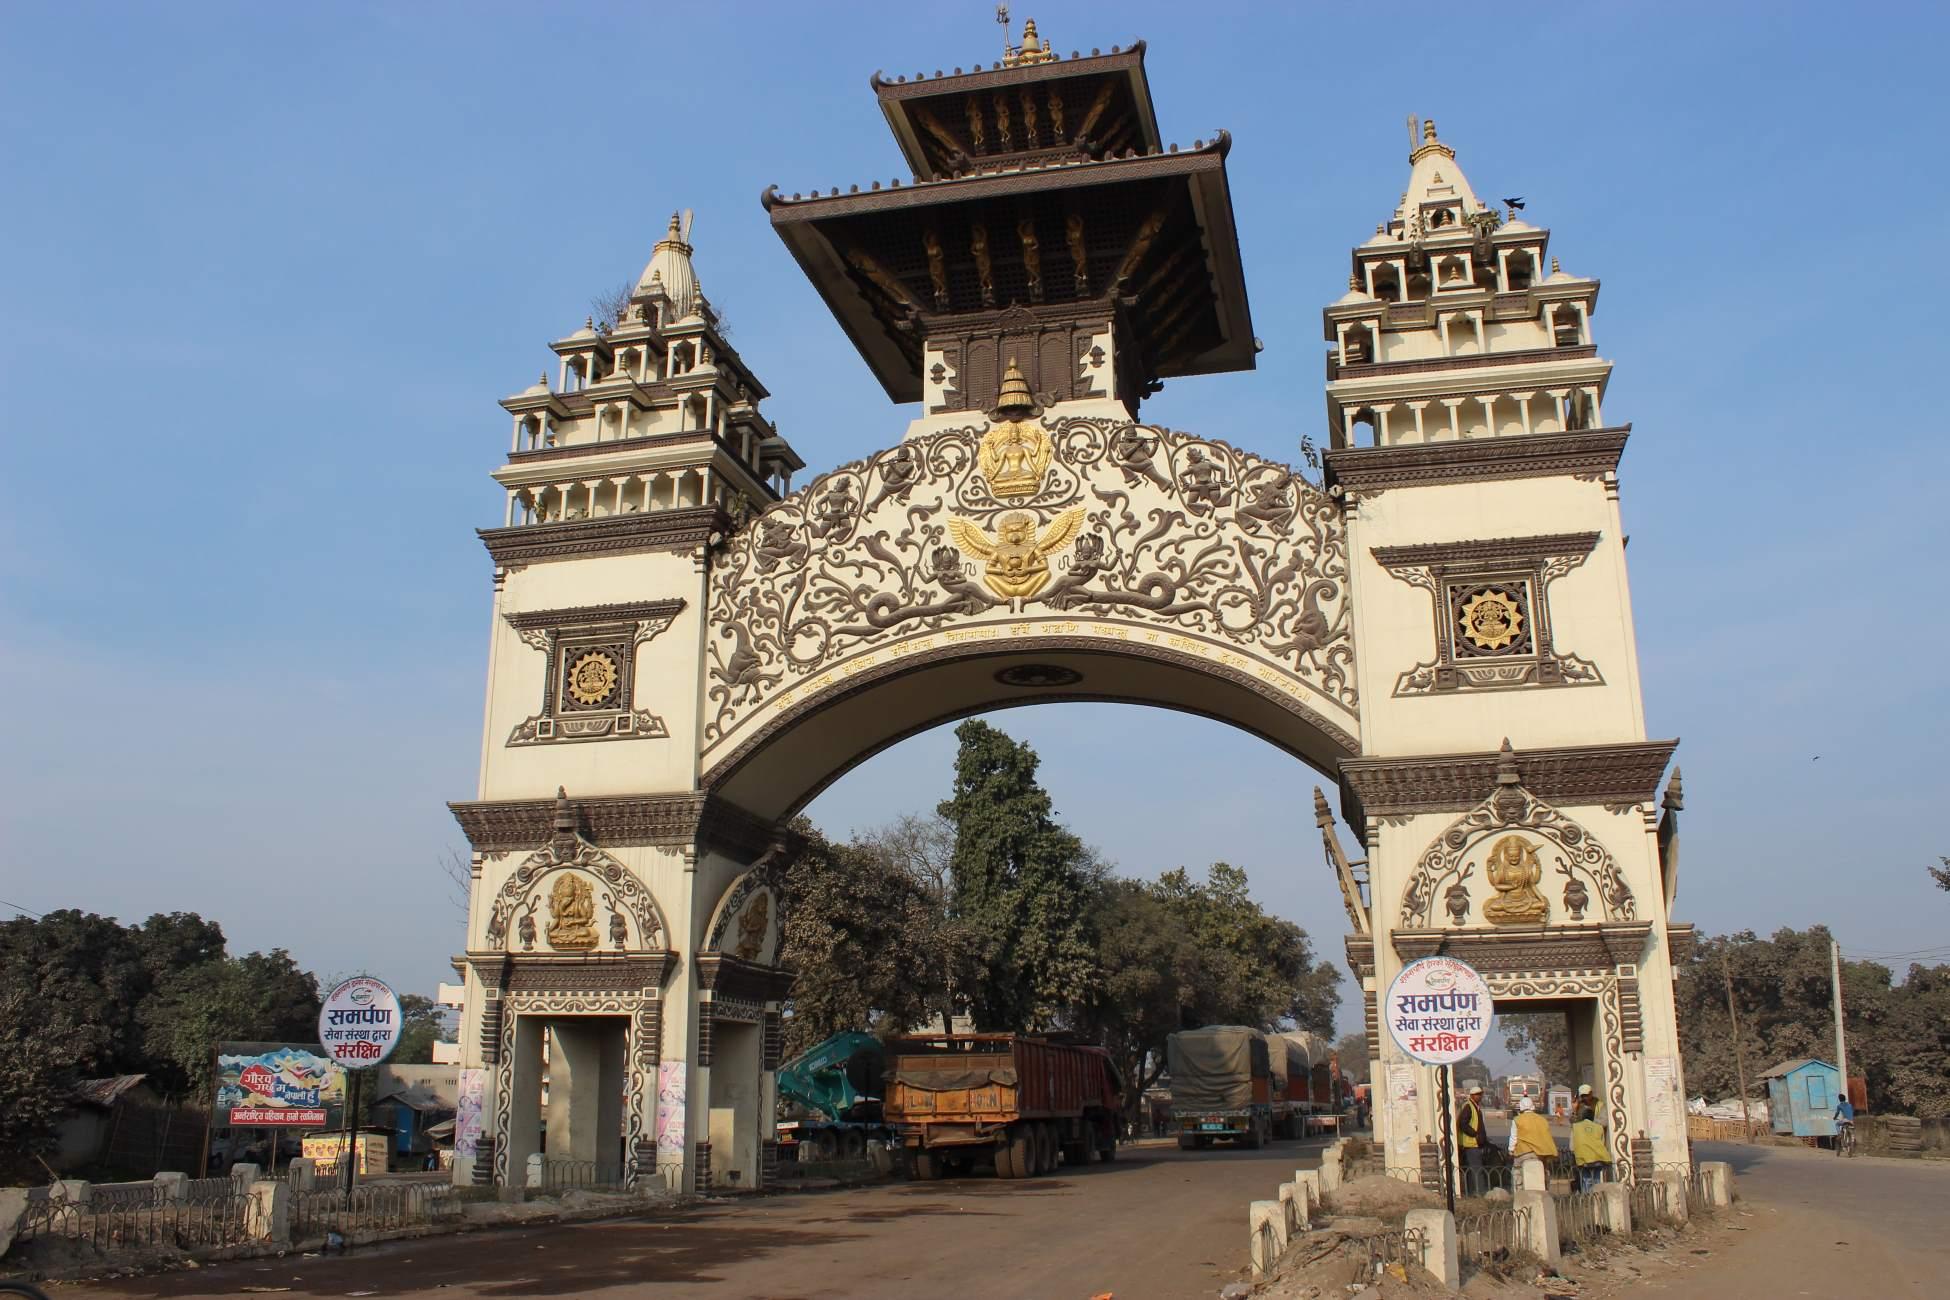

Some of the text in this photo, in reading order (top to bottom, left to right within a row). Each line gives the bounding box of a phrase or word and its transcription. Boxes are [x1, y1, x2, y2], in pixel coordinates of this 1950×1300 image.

[1396, 988, 1479, 1014] समर्पण
[328, 1005, 392, 1026] समर्पण
[1395, 1016, 1481, 1033] सेवा संस्था द्वारा
[324, 1027, 392, 1042] सेवा संस्था द्वारा
[1409, 1032, 1471, 1052] संरक्षित
[334, 1040, 382, 1059] संरक्षित
